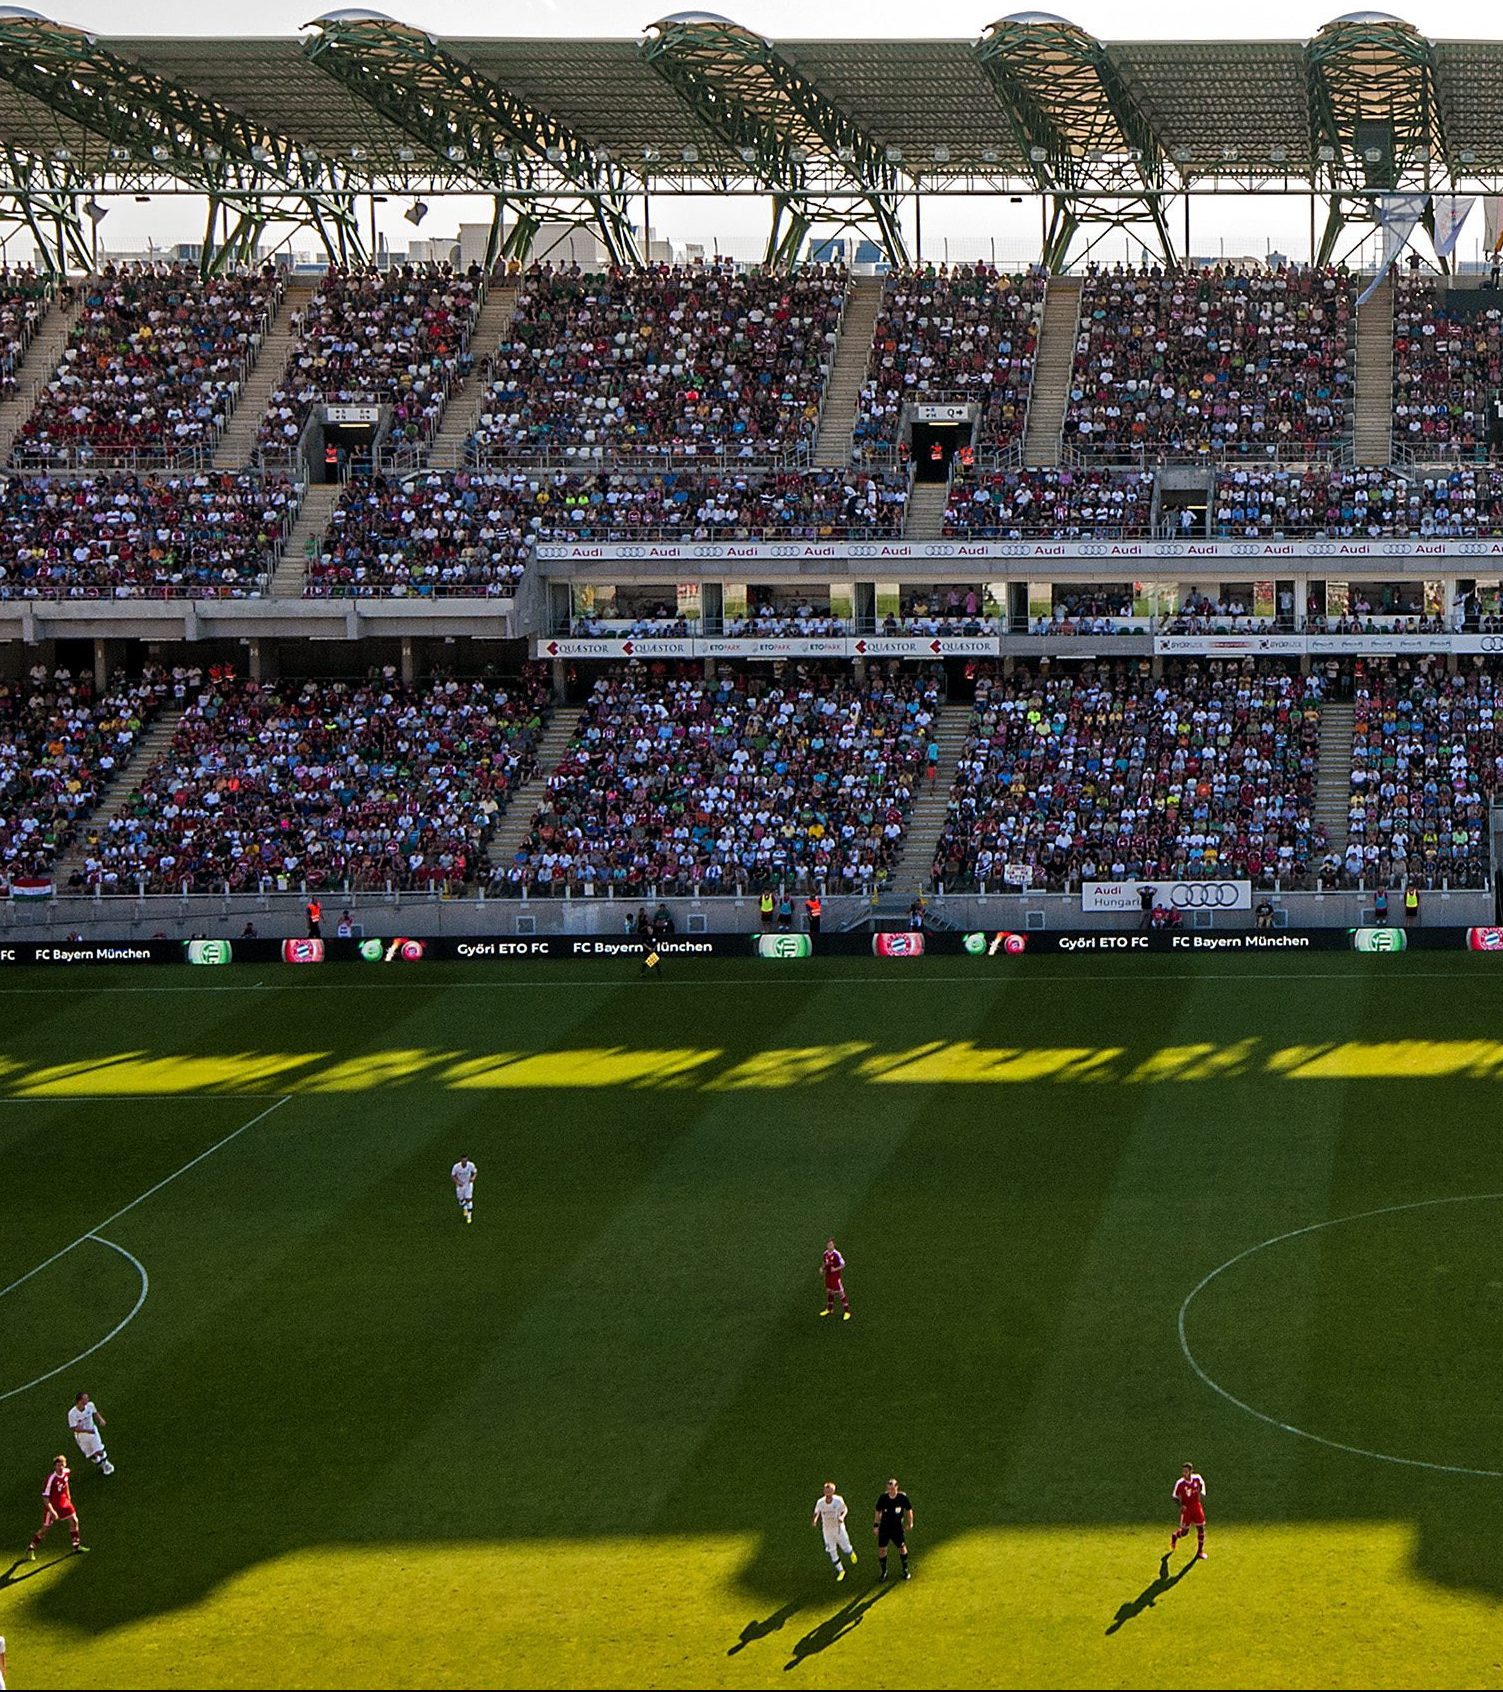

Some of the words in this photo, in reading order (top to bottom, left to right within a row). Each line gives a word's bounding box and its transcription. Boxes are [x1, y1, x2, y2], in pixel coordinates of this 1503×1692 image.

[947, 408, 955, 418] Q
[571, 547, 603, 557] Audi
[649, 547, 681, 557] Audi
[726, 547, 758, 557] Audi
[804, 547, 835, 557] Audi
[880, 546, 912, 556] Audi
[957, 546, 989, 556] Audi
[1034, 546, 1065, 556] Audi
[1111, 545, 1142, 555] Audi
[1187, 545, 1218, 555] Audi
[1263, 545, 1294, 555] Audi
[1339, 544, 1370, 554] Audi
[1415, 544, 1446, 554] Audi
[1094, 886, 1122, 895] Audi
[1094, 898, 1142, 908] Hungari
[573, 942, 592, 954] FC
[594, 942, 644, 956] Bayern
[1058, 937, 1096, 951] Győri
[1099, 936, 1128, 948] ETO
[1131, 936, 1149, 948] FC
[1172, 936, 1190, 948] FC
[1193, 936, 1242, 950] Bayern
[1245, 935, 1310, 947] München
[0, 949, 16, 961] FC
[35, 948, 51, 960] FC
[52, 948, 94, 962] Bayern
[96, 947, 151, 960] München
[457, 943, 495, 957] Győri
[498, 942, 528, 954] ETO
[531, 942, 549, 954] FC
